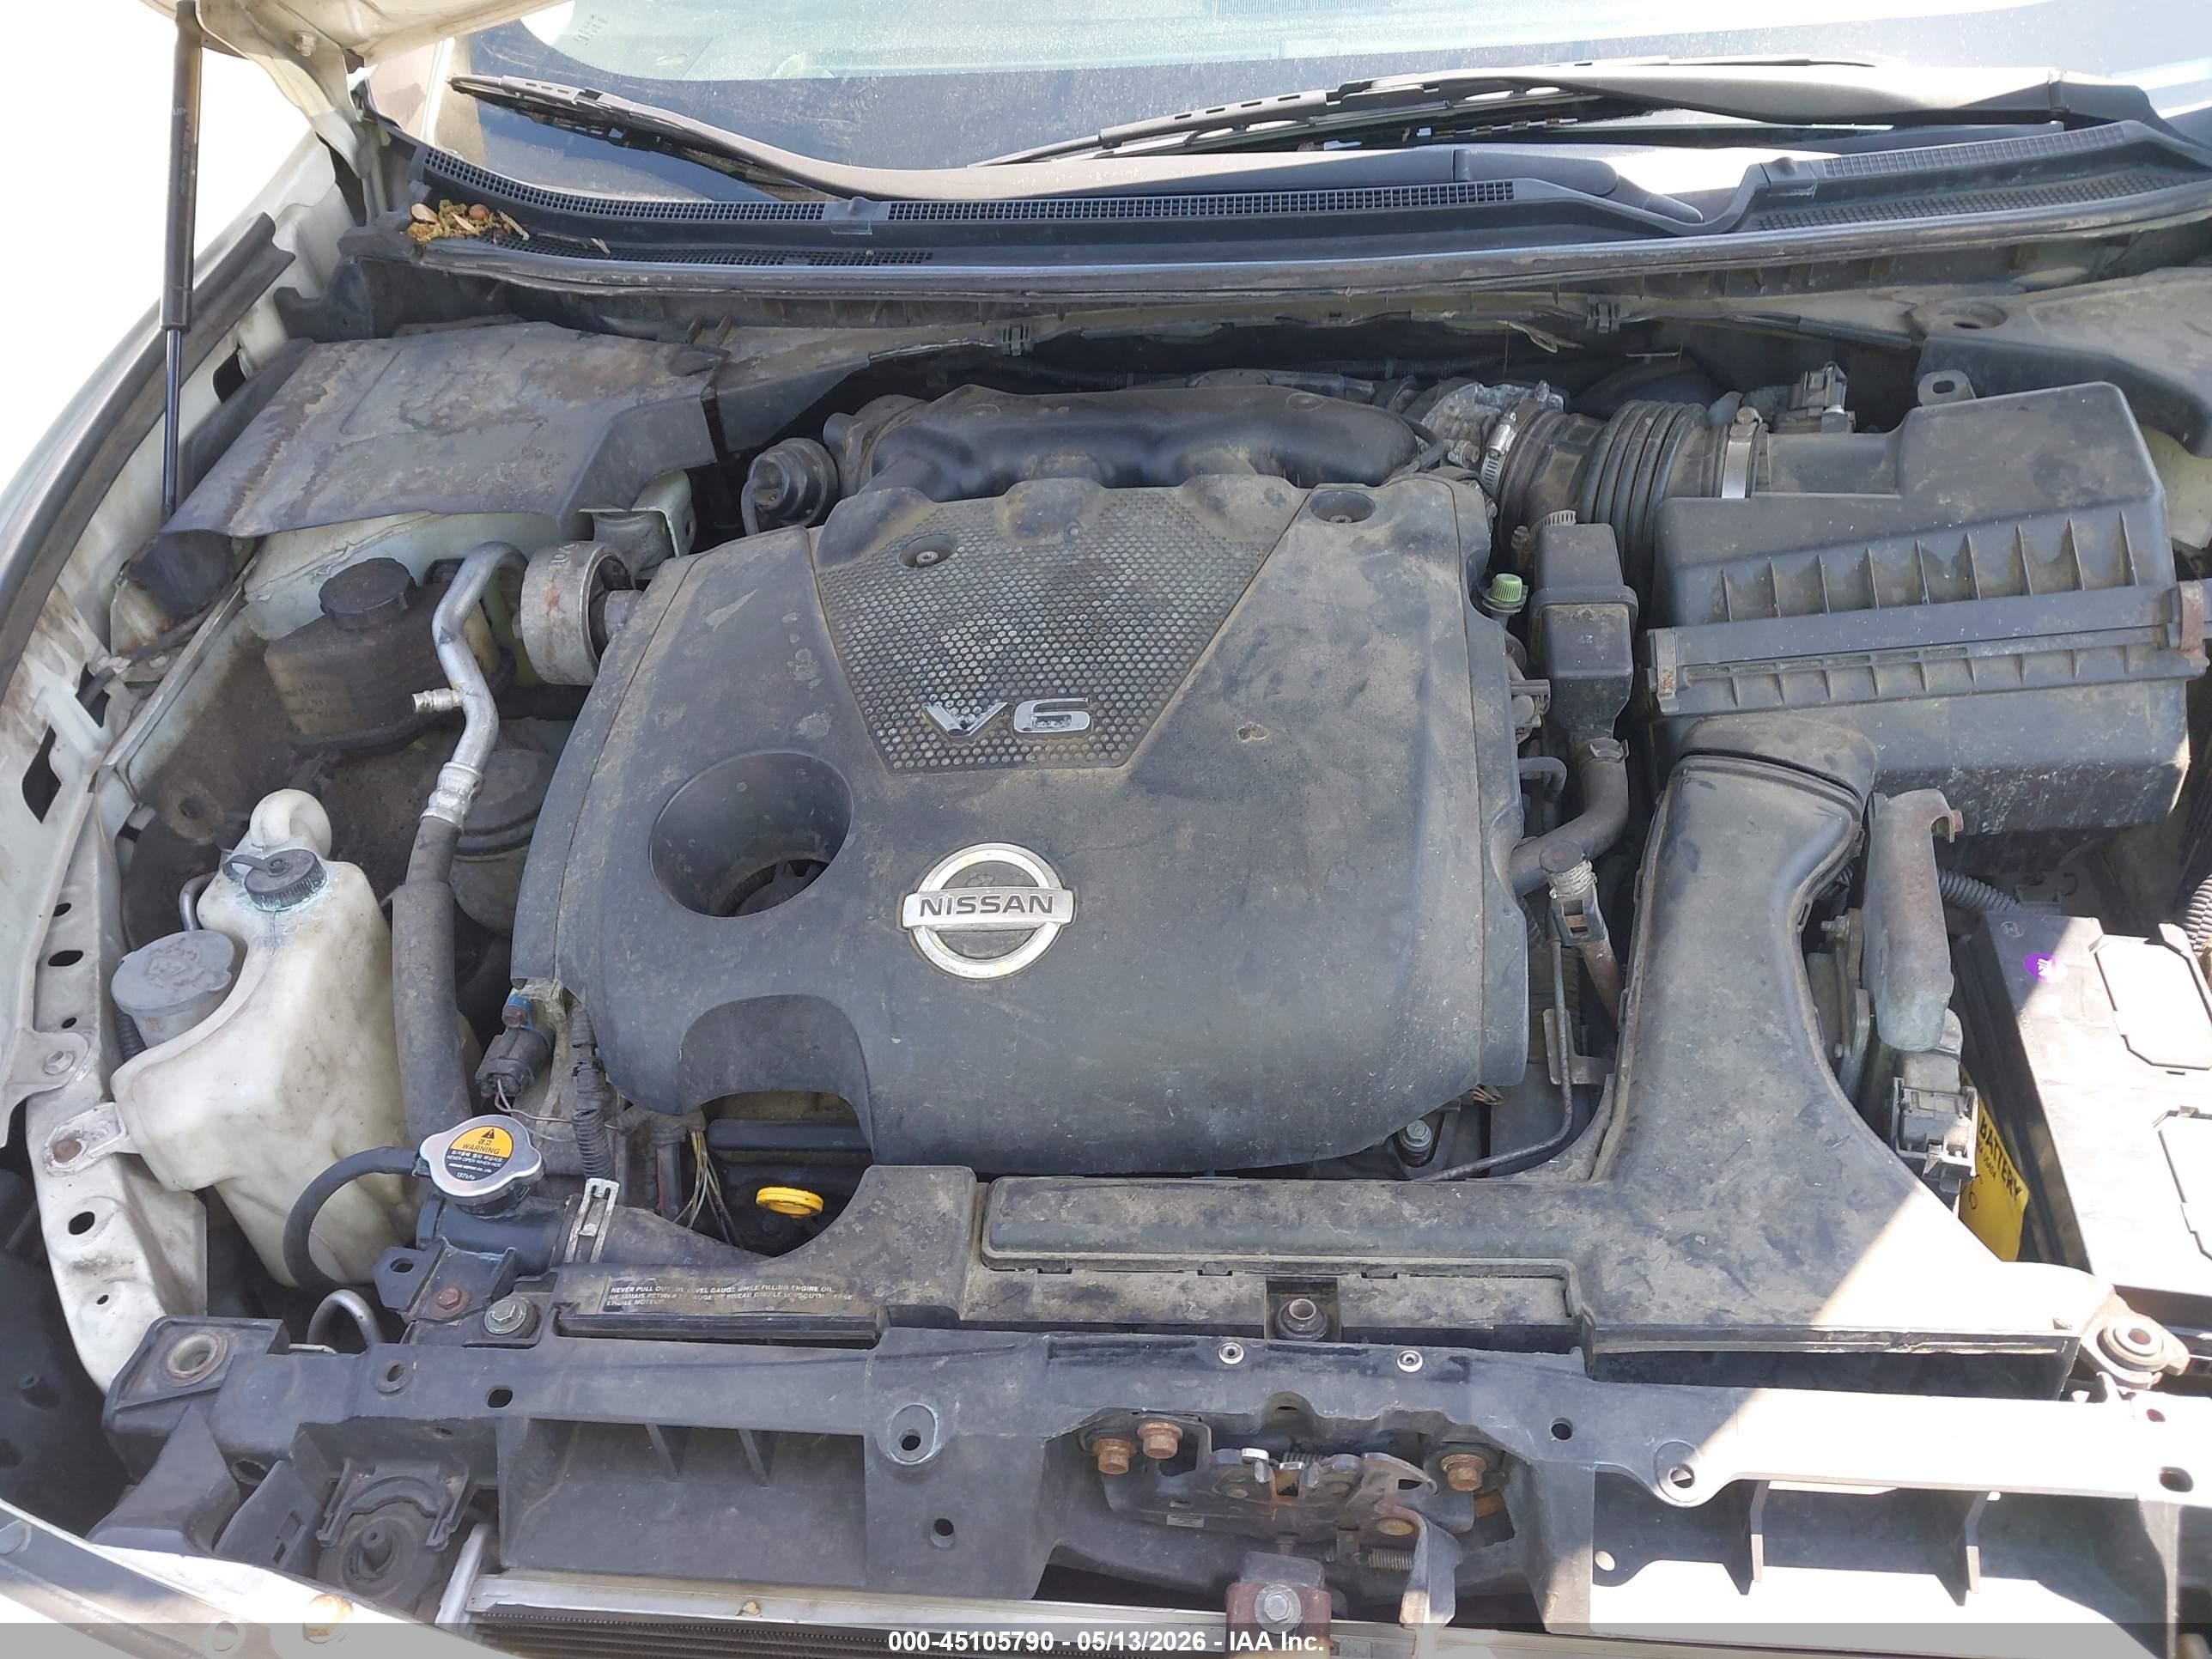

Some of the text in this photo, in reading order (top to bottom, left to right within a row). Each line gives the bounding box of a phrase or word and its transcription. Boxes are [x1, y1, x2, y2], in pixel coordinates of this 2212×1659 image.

[921, 696, 1093, 738] V6
[920, 894, 1054, 917] NISSAN
[463, 1143, 500, 1154] WARNING
